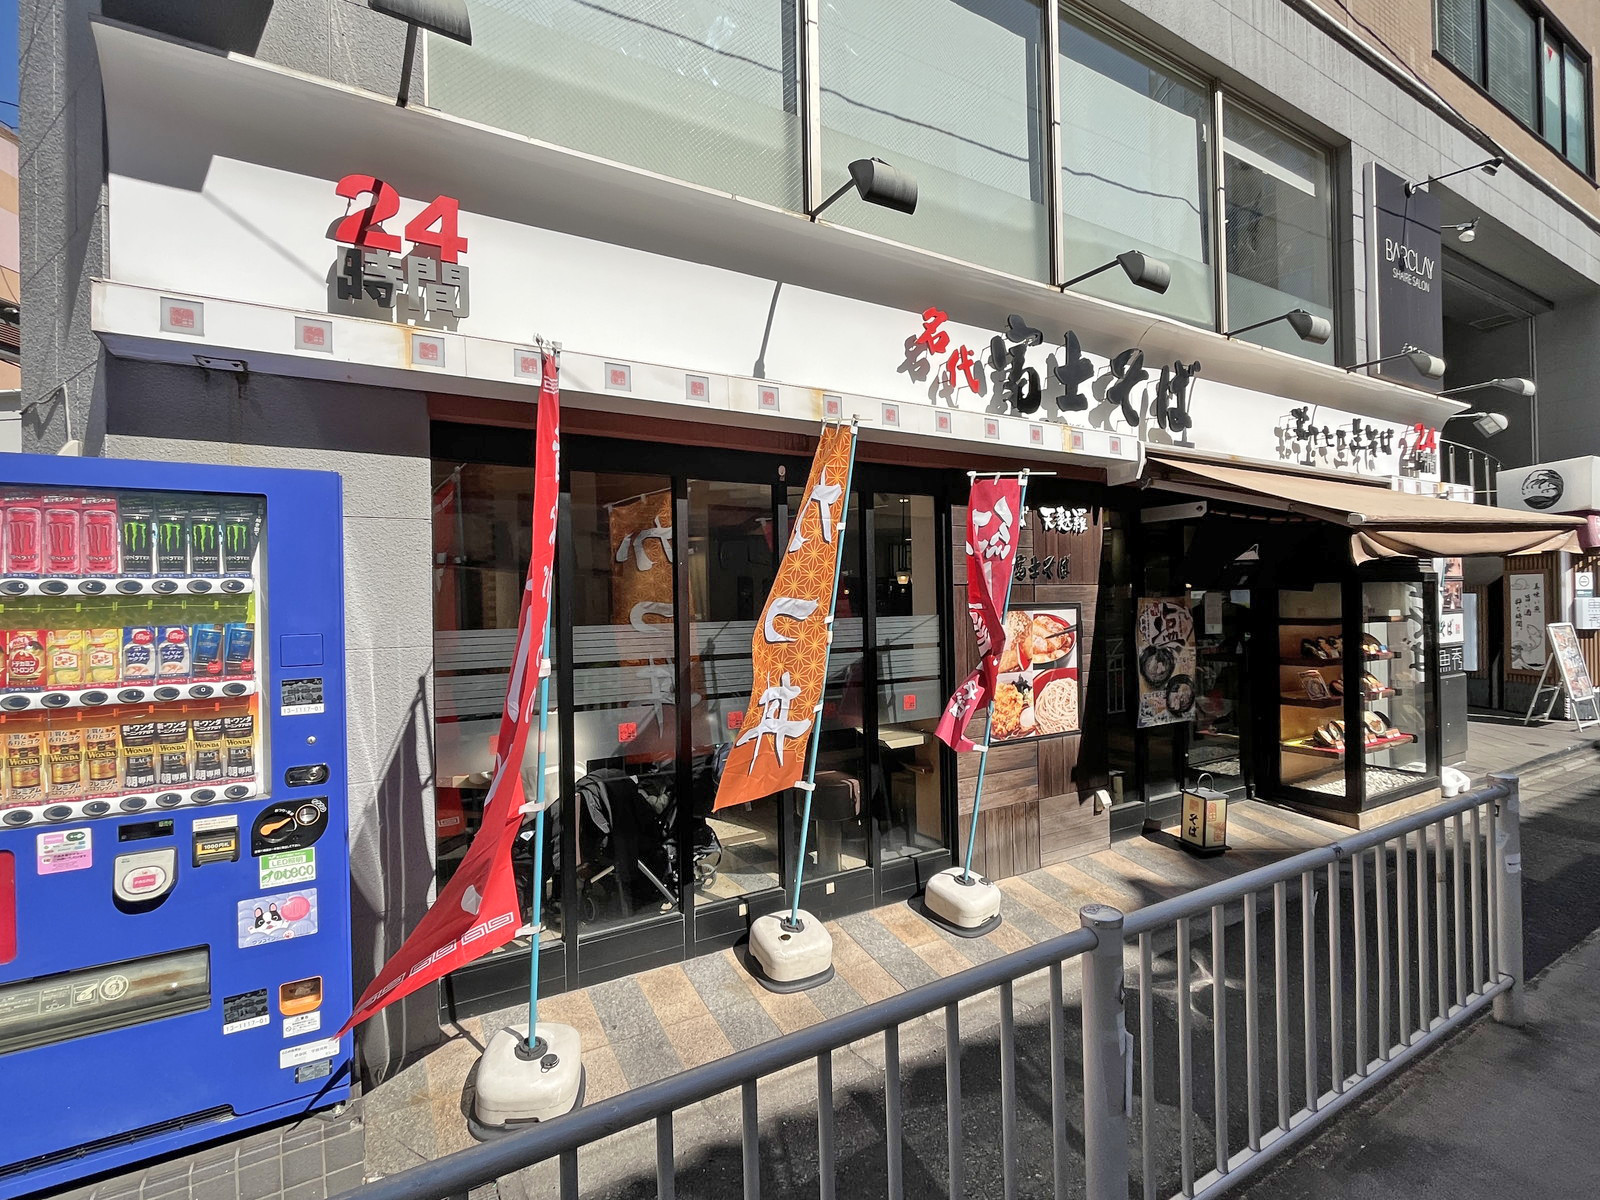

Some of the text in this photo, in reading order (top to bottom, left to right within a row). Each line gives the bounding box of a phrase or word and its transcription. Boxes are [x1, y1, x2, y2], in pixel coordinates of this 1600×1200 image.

[336, 174, 469, 264] 24
[1385, 238, 1434, 279] BARCLAY
[336, 246, 470, 318] 時間
[919, 306, 980, 394] 名代
[1414, 422, 1437, 454] 24
[9, 758, 39, 766] WONDA
[50, 754, 79, 762] WONDA
[125, 747, 152, 755] WONDA
[160, 744, 185, 752] WONDA
